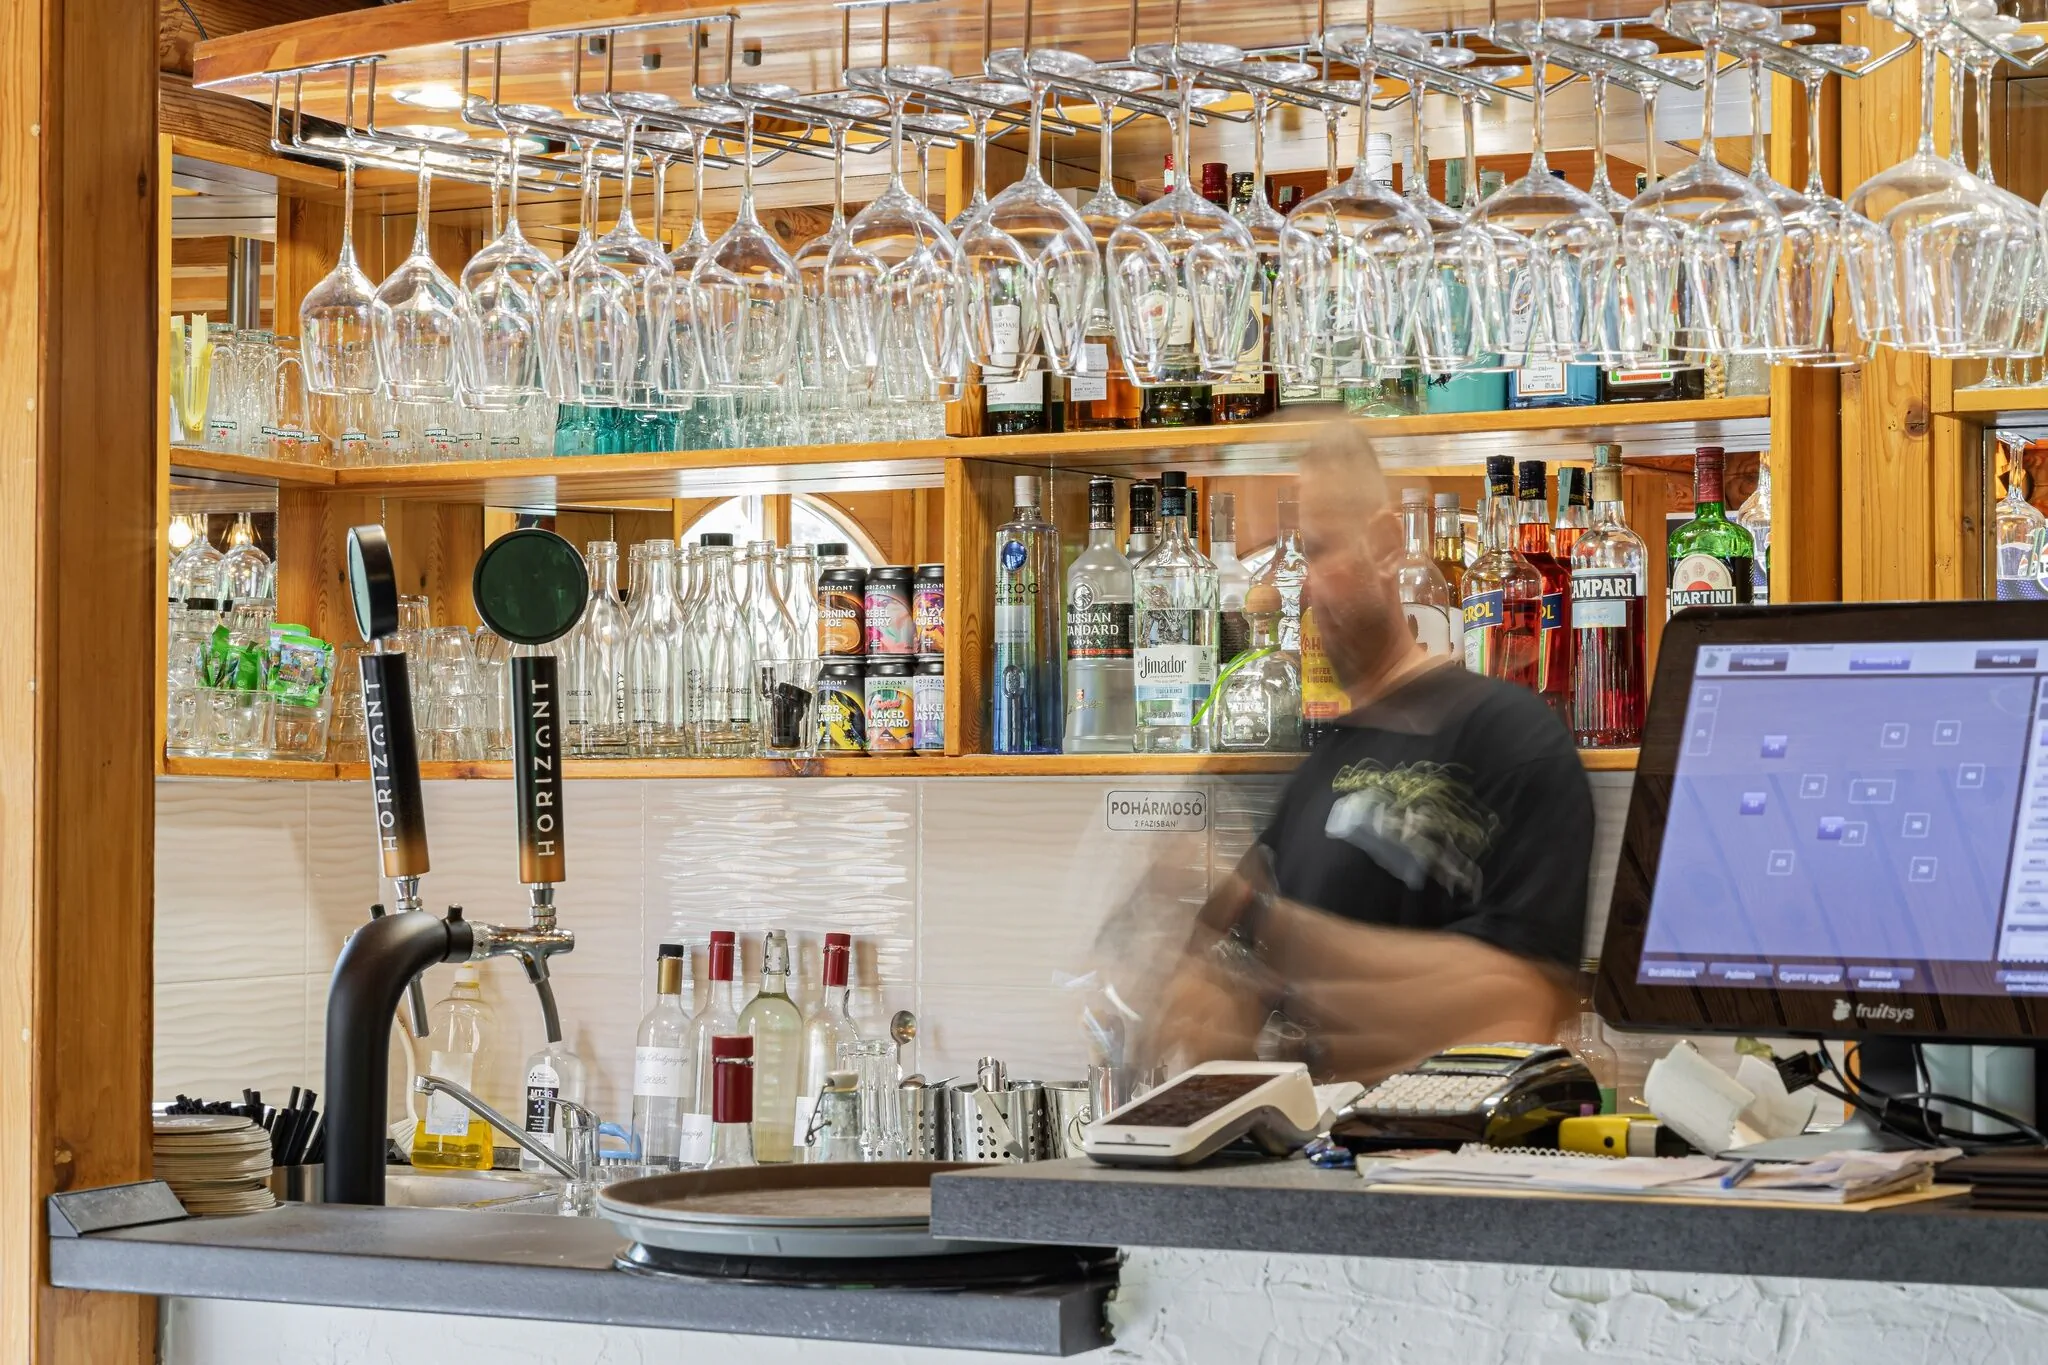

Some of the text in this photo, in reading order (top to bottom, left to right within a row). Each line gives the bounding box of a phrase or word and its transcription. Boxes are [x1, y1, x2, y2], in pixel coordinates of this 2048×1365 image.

[1572, 578, 1633, 598] AMPARI
[1673, 591, 1732, 604] MARTINI
[819, 609, 856, 618] ORNING
[866, 609, 889, 617] REBEL
[917, 608, 943, 617] HAZY
[1464, 601, 1494, 624] EROL
[825, 619, 842, 627] JOE
[866, 618, 891, 627] BERRY
[1067, 624, 1119, 636] TANDARD
[1140, 655, 1187, 678] Jimador
[818, 704, 840, 713] HERR
[917, 704, 944, 712] NAKE
[817, 713, 843, 722] LAGER
[871, 710, 905, 719] NAKED
[915, 712, 944, 721] BASTA
[868, 719, 910, 728] BASTARD
[364, 679, 398, 851] HORIZONT
[531, 679, 556, 857] HORIZONT
[1111, 797, 1203, 816] POHÁRMOSÓ
[1856, 1003, 1915, 1023] fruitsys
[531, 1088, 553, 1098] MT36
